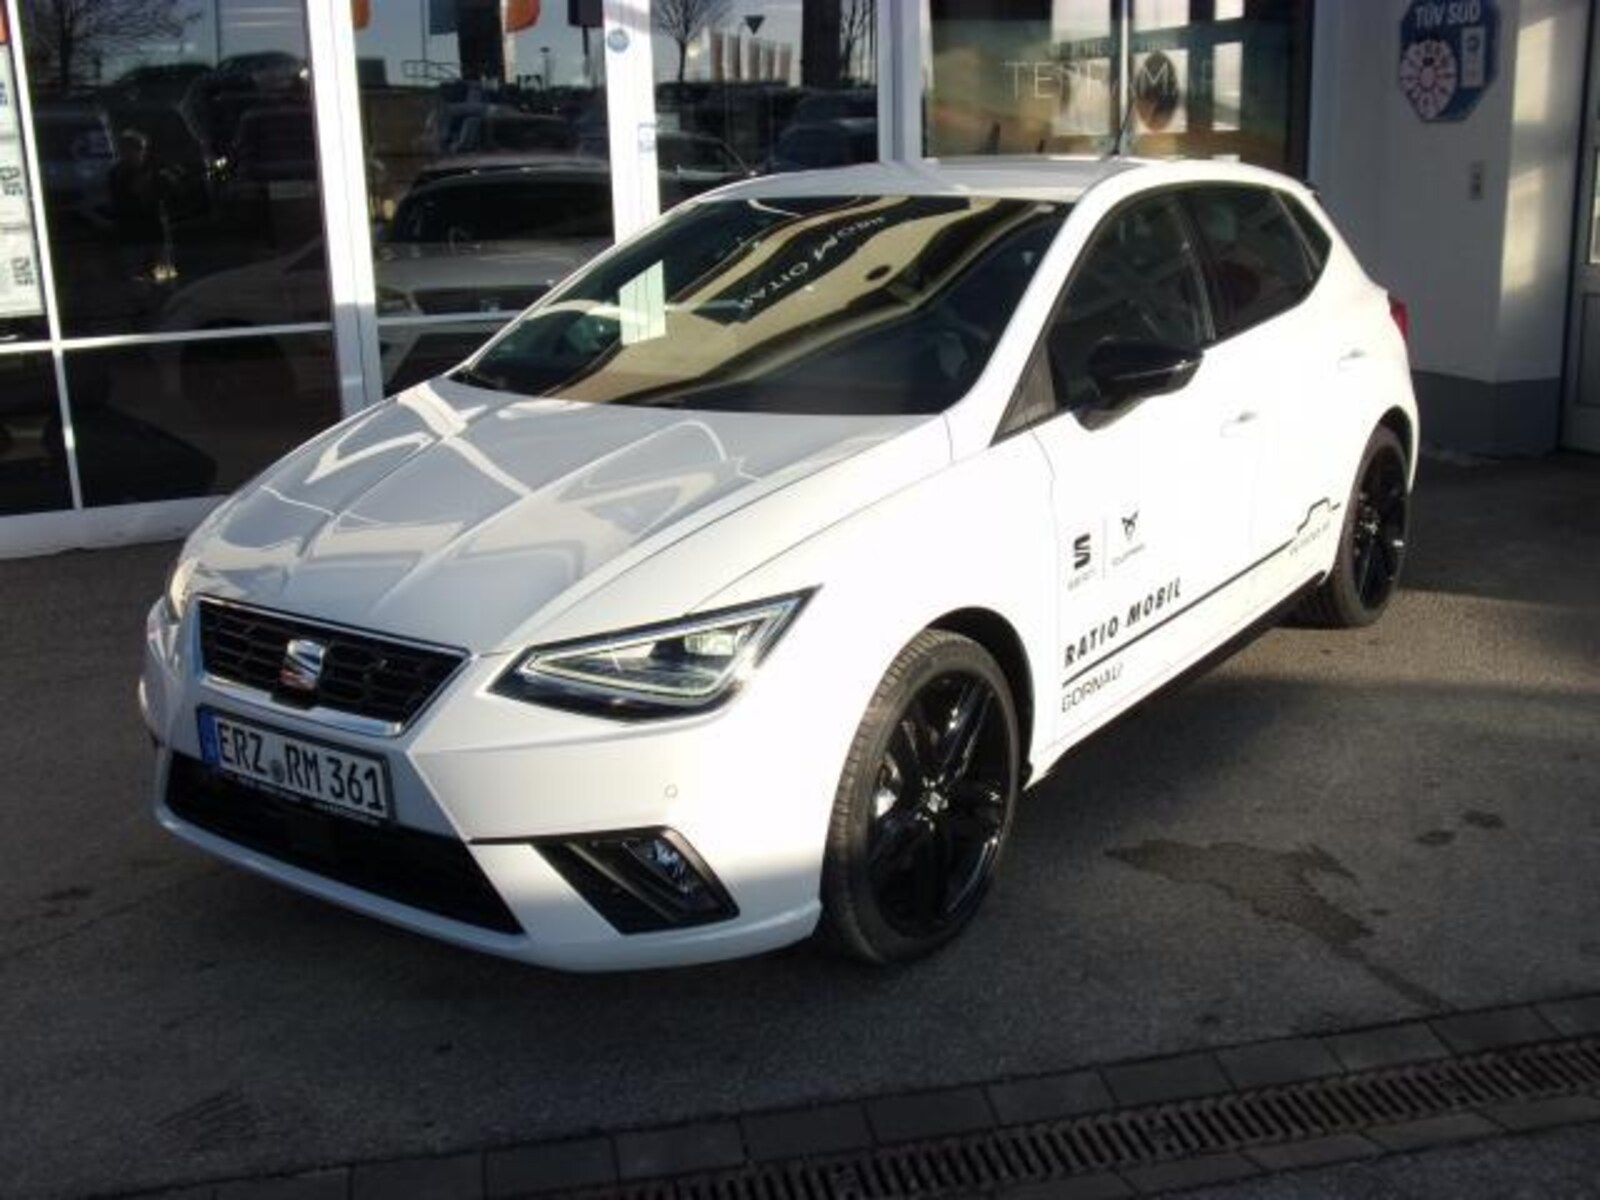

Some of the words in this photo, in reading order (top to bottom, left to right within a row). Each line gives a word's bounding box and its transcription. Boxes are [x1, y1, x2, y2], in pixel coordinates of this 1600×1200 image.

[1064, 617, 1119, 667] RATIO
[1127, 577, 1182, 628] MOBIL
[1061, 664, 1123, 711] GORNAU
[217, 722, 267, 774] ERZ
[284, 744, 323, 793] RM
[327, 758, 383, 810] 361
